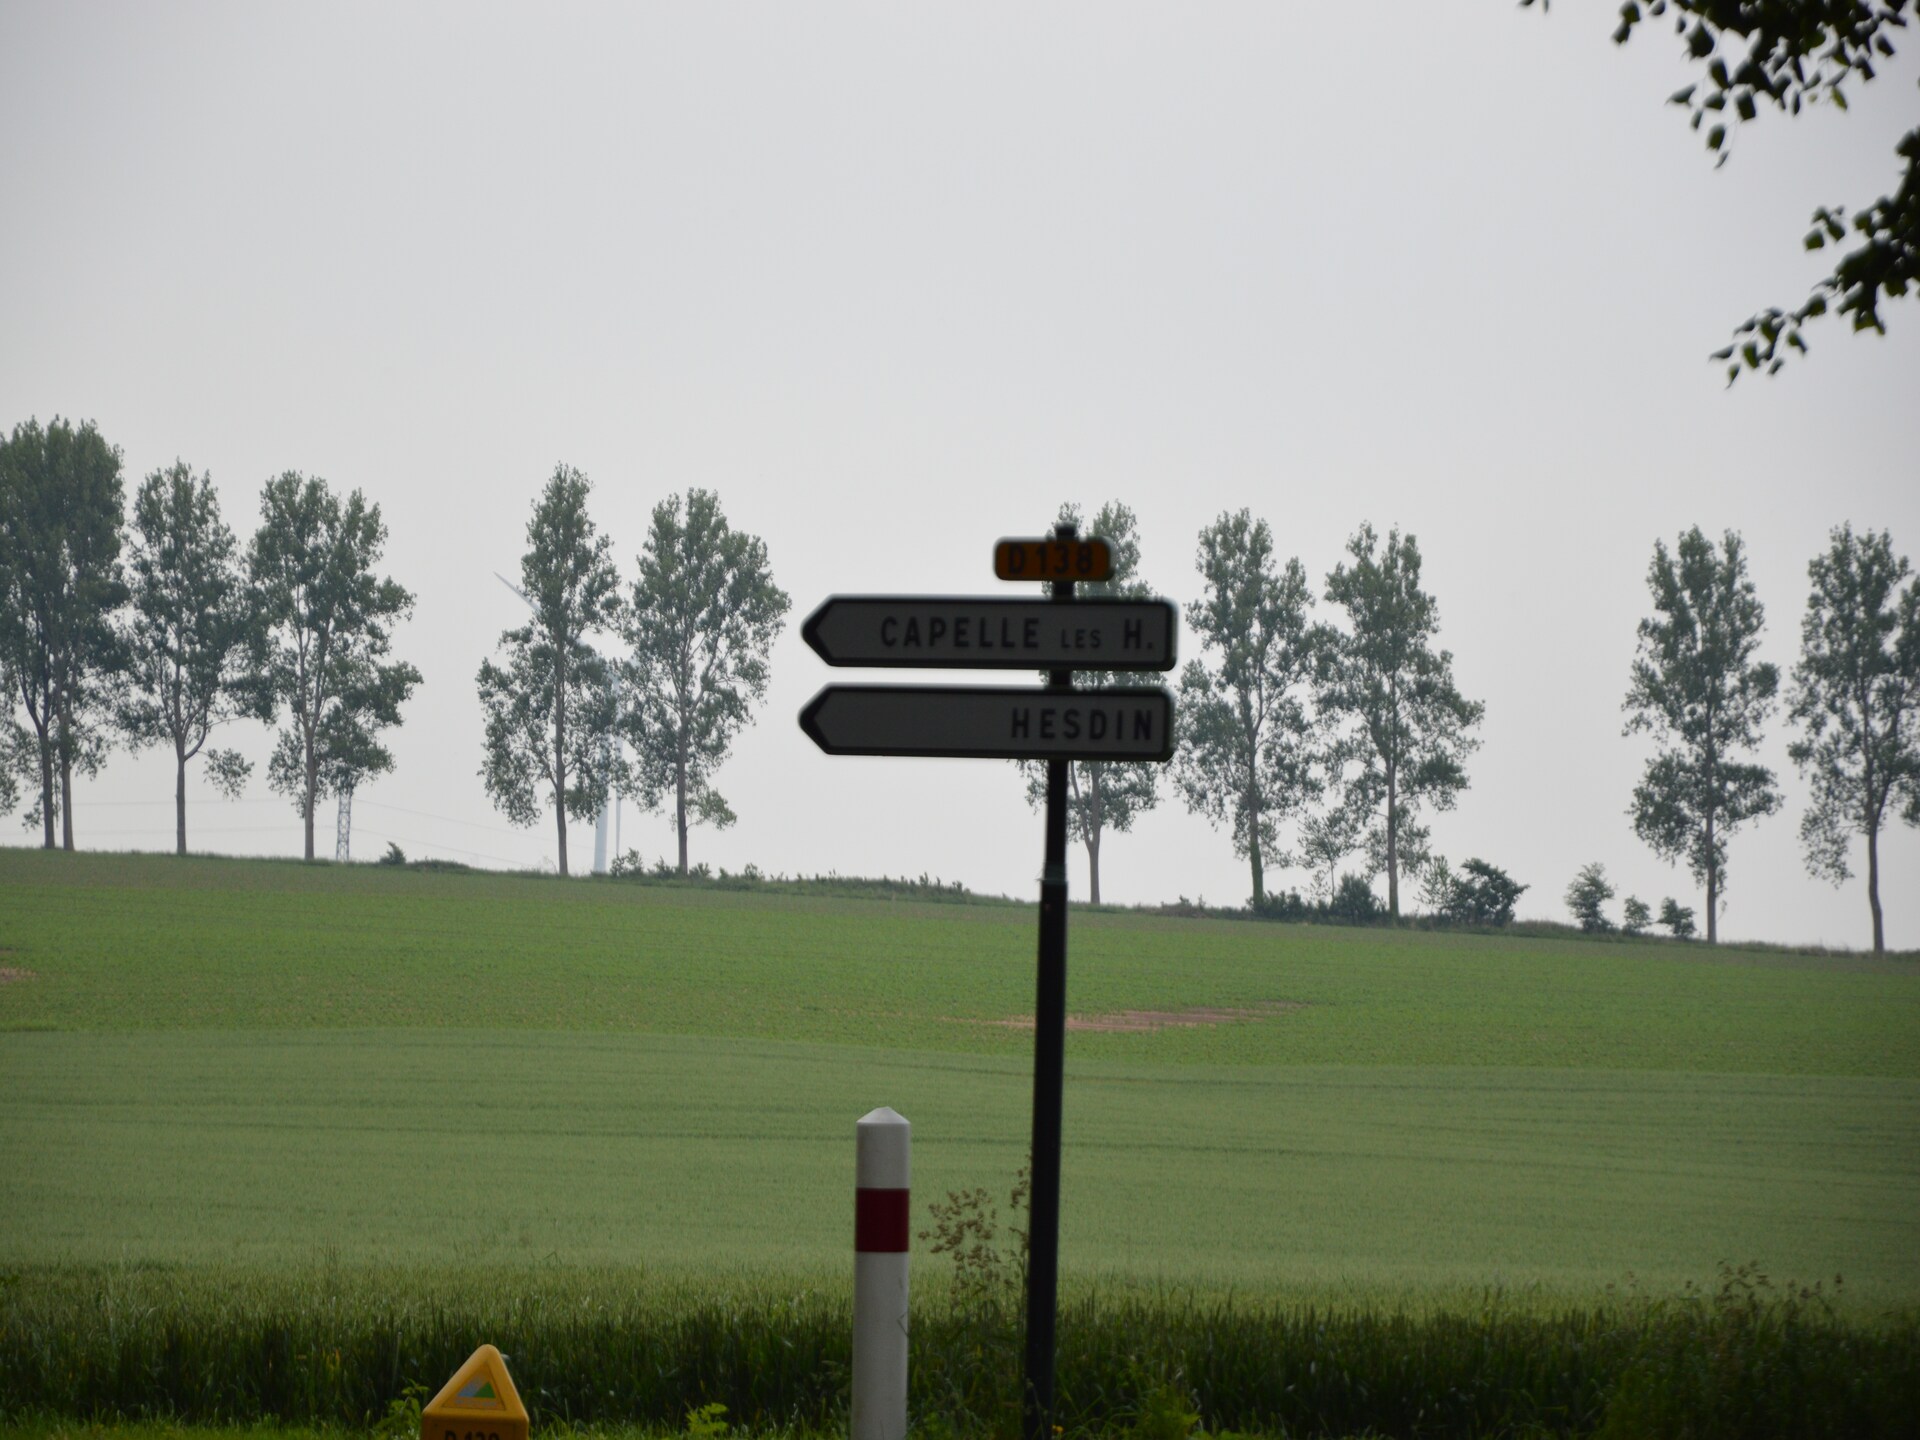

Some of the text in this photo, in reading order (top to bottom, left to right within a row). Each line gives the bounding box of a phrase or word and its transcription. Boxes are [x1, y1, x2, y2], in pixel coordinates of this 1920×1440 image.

[880, 616, 1155, 650] CAPELLE LES H.
[1011, 709, 1153, 741] HESDIN
